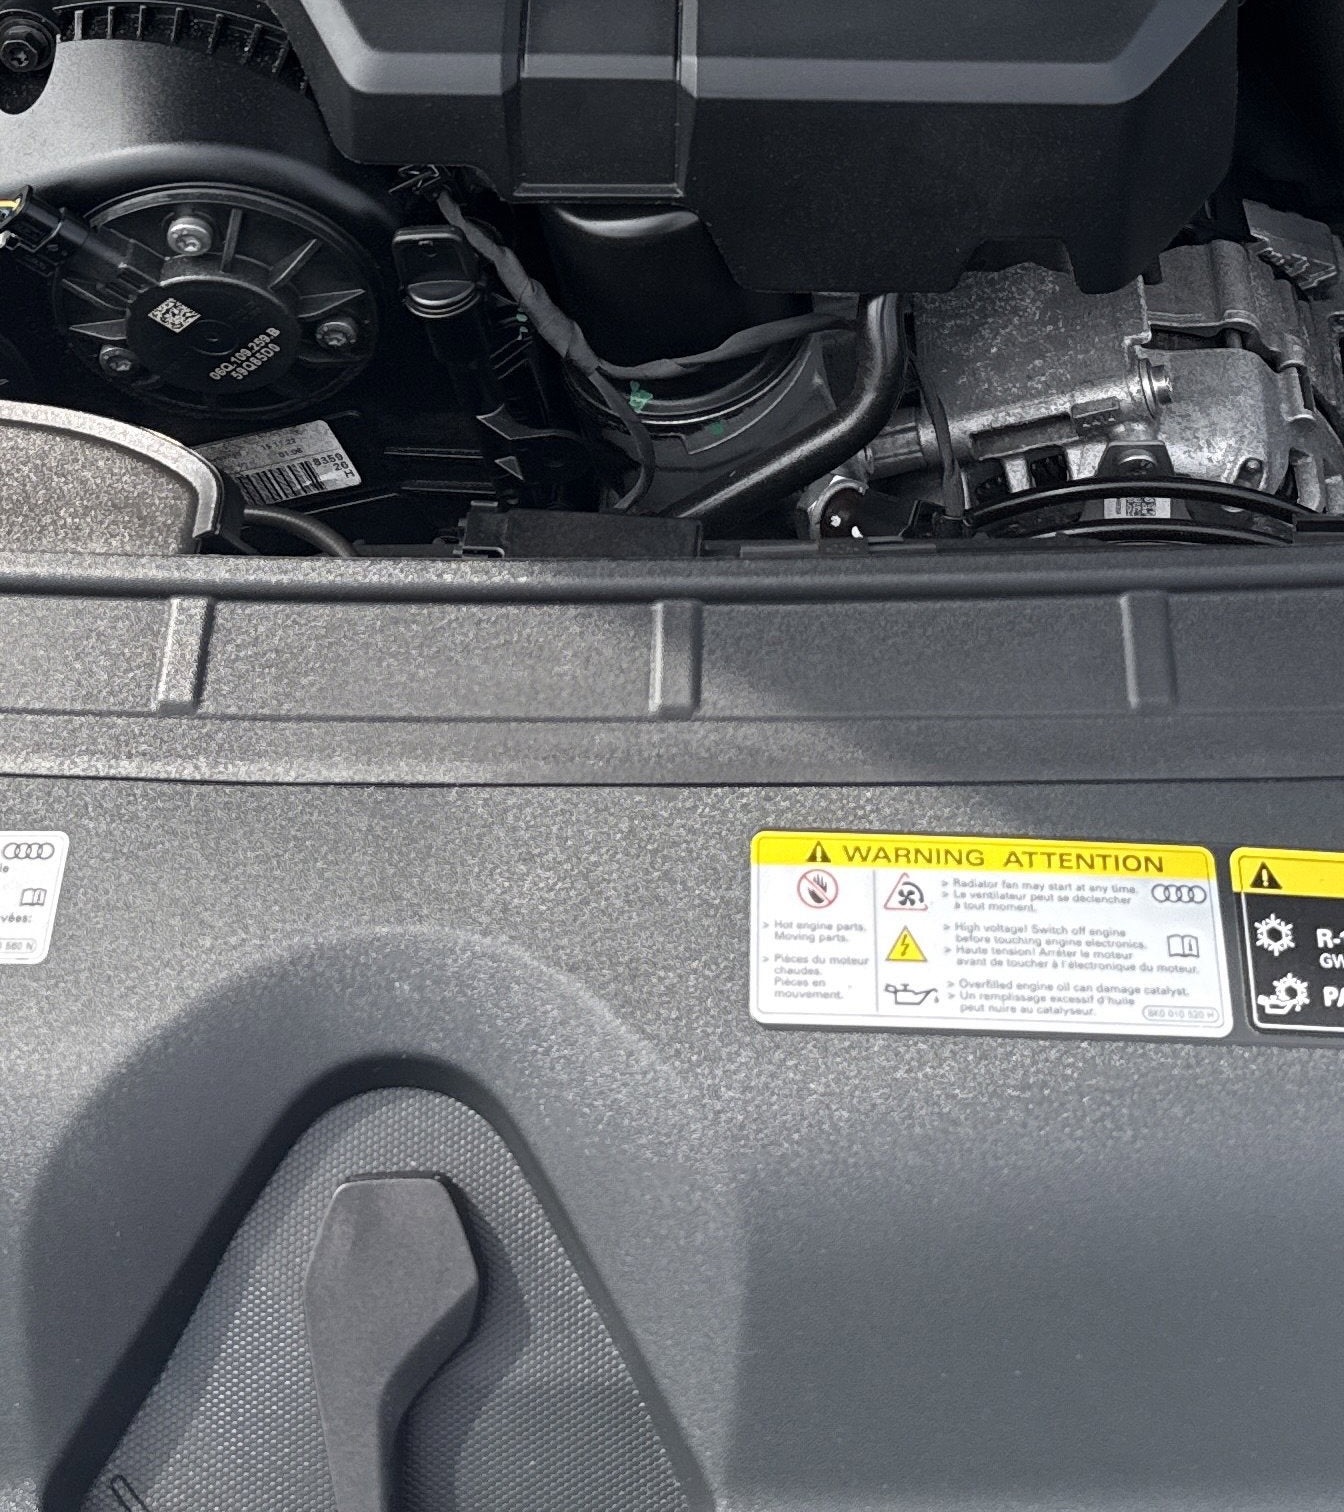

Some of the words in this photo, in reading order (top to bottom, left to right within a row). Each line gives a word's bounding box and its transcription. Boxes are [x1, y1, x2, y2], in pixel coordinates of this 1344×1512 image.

[842, 845, 985, 867] WARNING
[1002, 850, 1164, 873] ATTENTION
[828, 956, 870, 966] moteur
[1092, 950, 1134, 961] moteur
